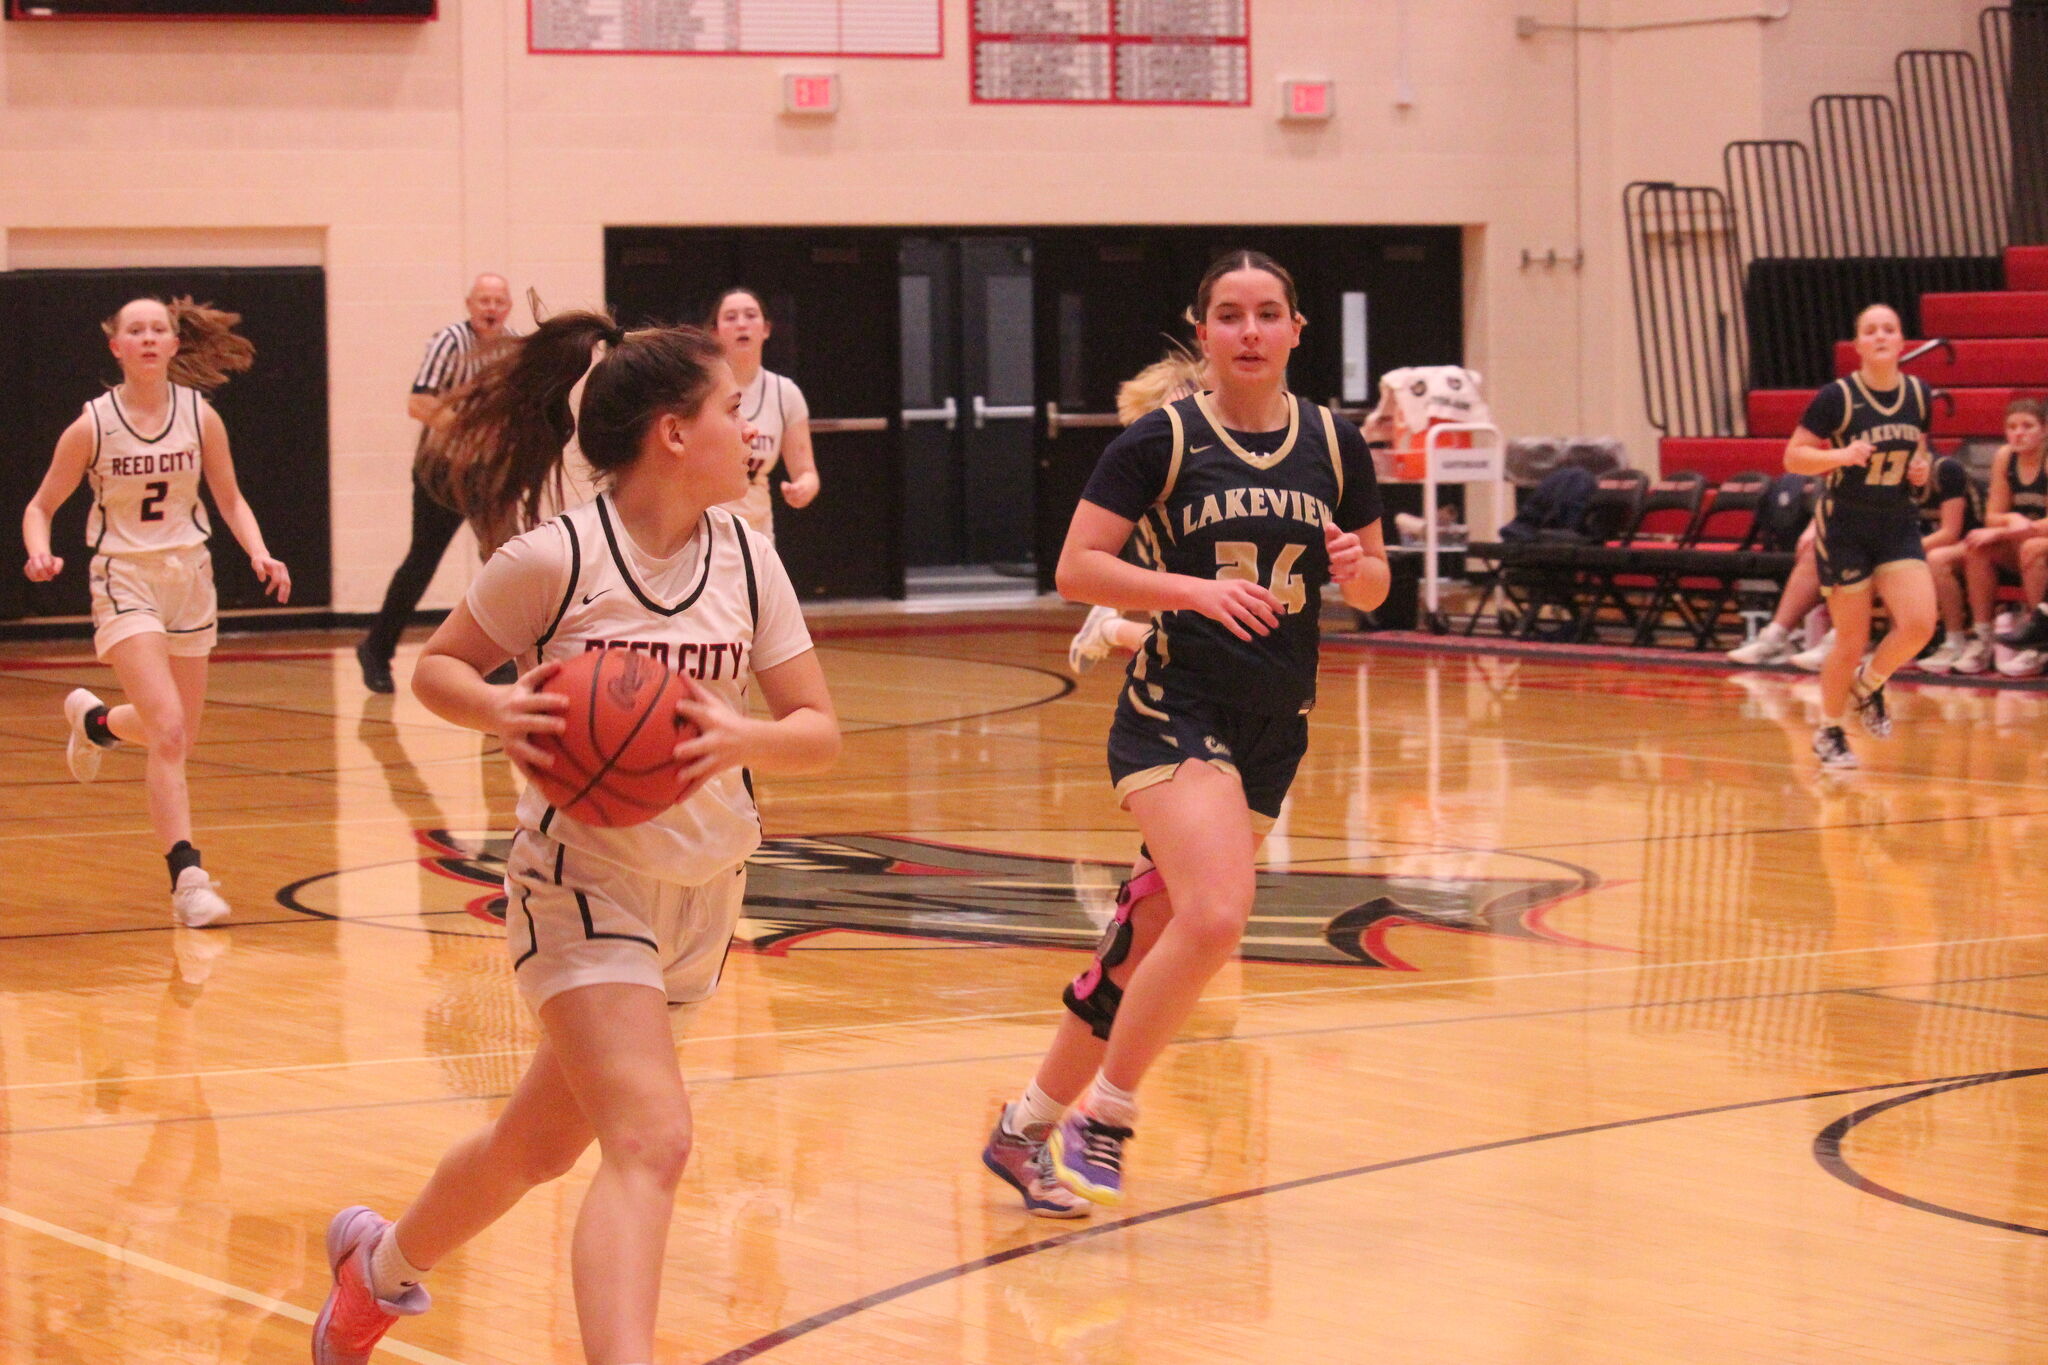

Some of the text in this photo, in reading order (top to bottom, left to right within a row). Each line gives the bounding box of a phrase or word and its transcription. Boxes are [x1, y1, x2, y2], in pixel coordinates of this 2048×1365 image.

[111, 450, 195, 476] REED CITY
[140, 481, 169, 522] 2
[677, 641, 744, 681] CITY
